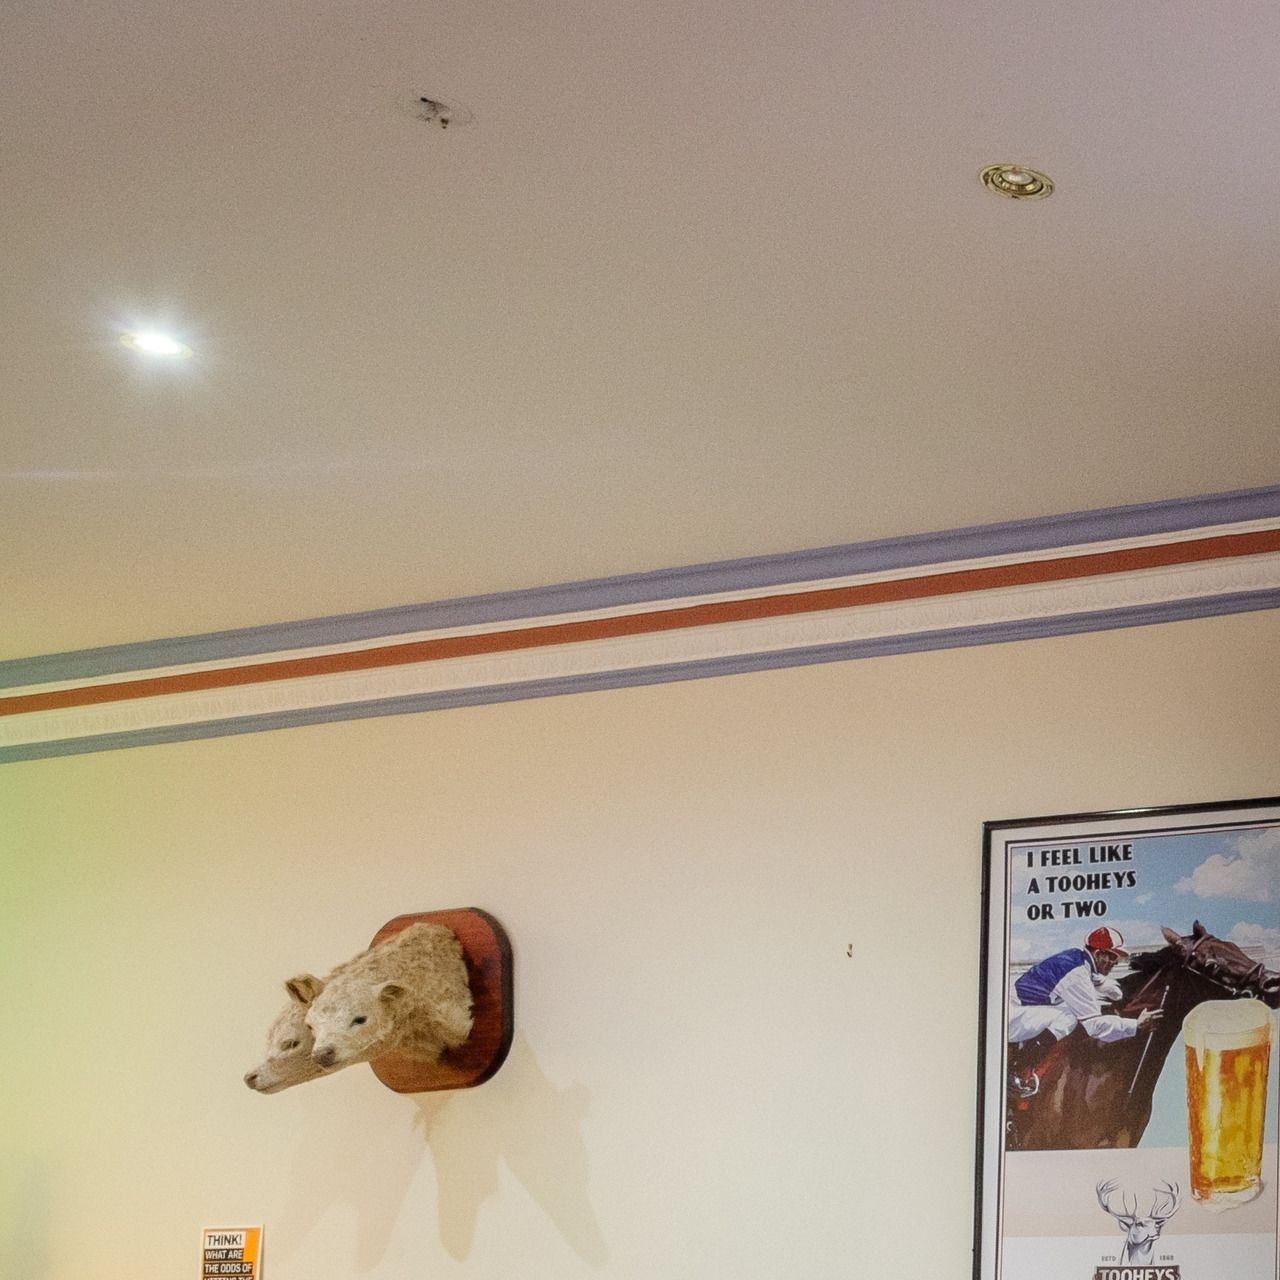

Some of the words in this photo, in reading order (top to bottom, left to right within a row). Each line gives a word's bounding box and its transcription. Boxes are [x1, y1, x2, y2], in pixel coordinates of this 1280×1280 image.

[1026, 850, 1034, 868] I
[1040, 848, 1083, 866] FEEL
[1088, 844, 1134, 864] LIKE
[1028, 875, 1040, 895] A
[1044, 870, 1137, 893] TOOHEYS
[1026, 901, 1055, 921] OR
[1061, 899, 1107, 919] TWO
[207, 1234, 242, 1246] THINK!
[205, 1250, 226, 1259] WHAT
[228, 1250, 243, 1259] ARE
[205, 1264, 219, 1273] THE
[220, 1264, 241, 1273] ODDS
[242, 1264, 252, 1272] OF
